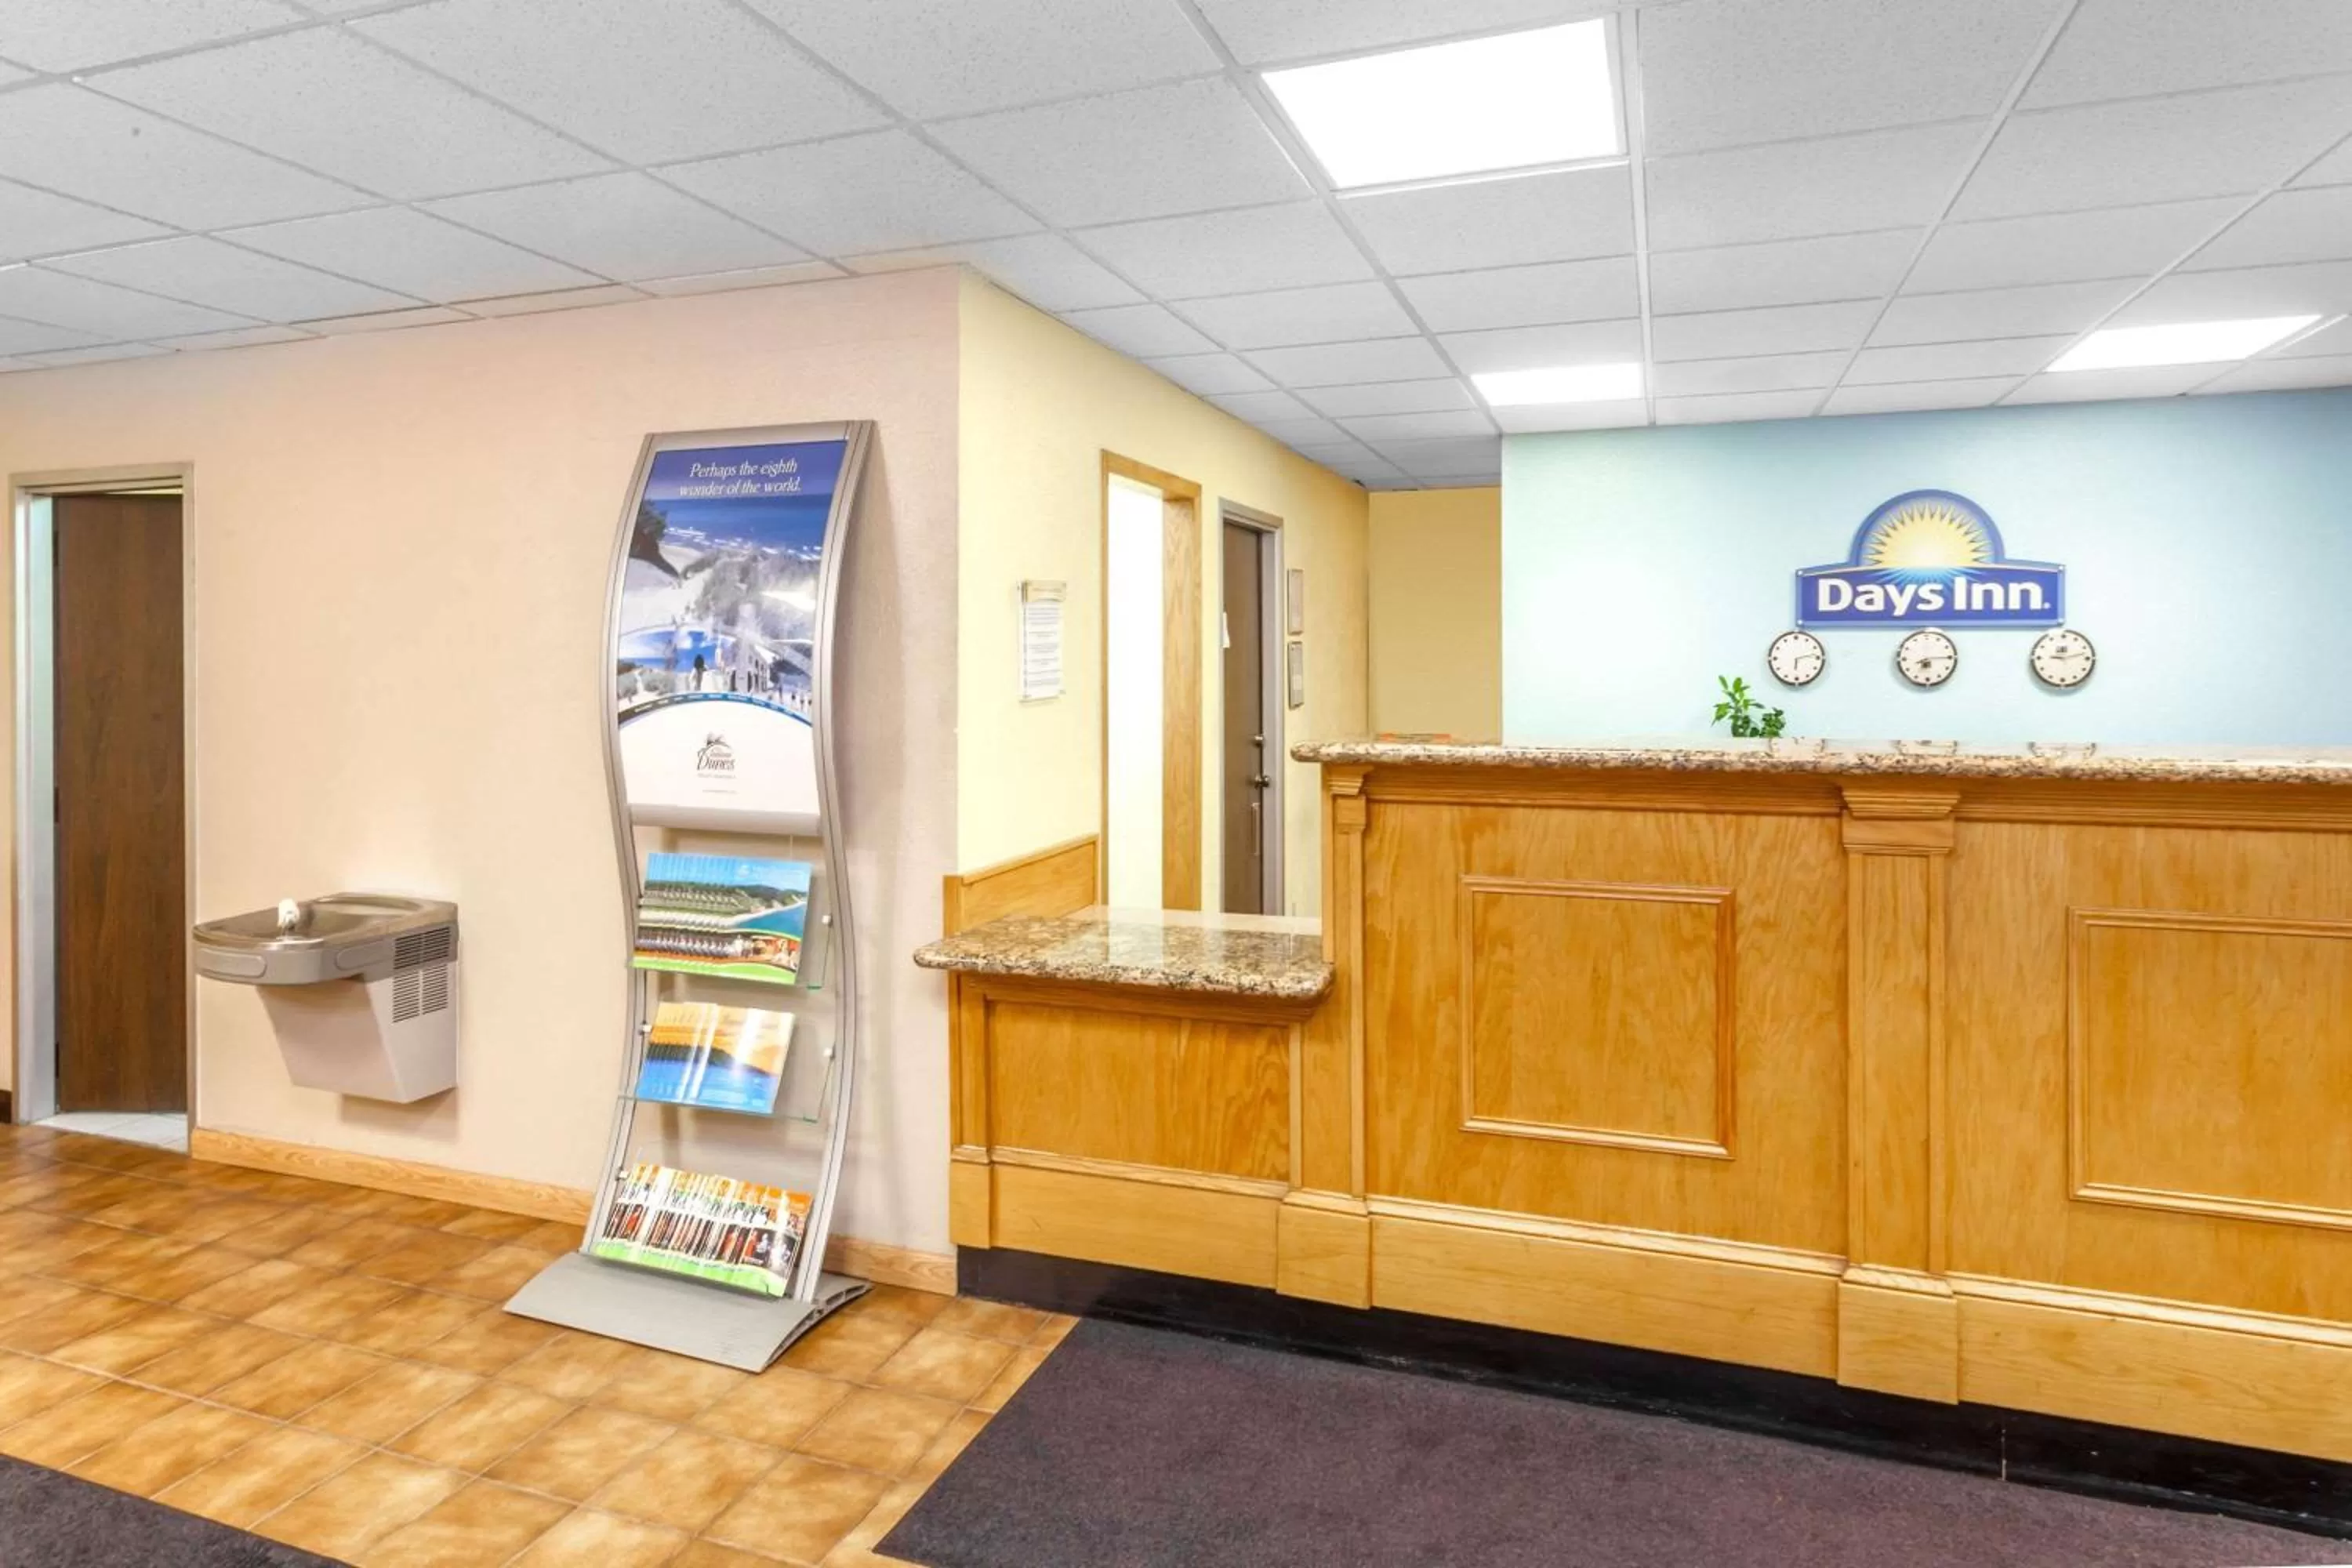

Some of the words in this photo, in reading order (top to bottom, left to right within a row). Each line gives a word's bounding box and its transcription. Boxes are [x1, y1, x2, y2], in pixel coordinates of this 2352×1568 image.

[690, 462, 737, 481] Perhaps
[739, 459, 760, 476] the
[760, 457, 798, 477] eighth
[680, 480, 723, 497] wonder
[726, 478, 742, 495] of
[741, 478, 761, 494] the
[1817, 576, 1944, 616] Days
